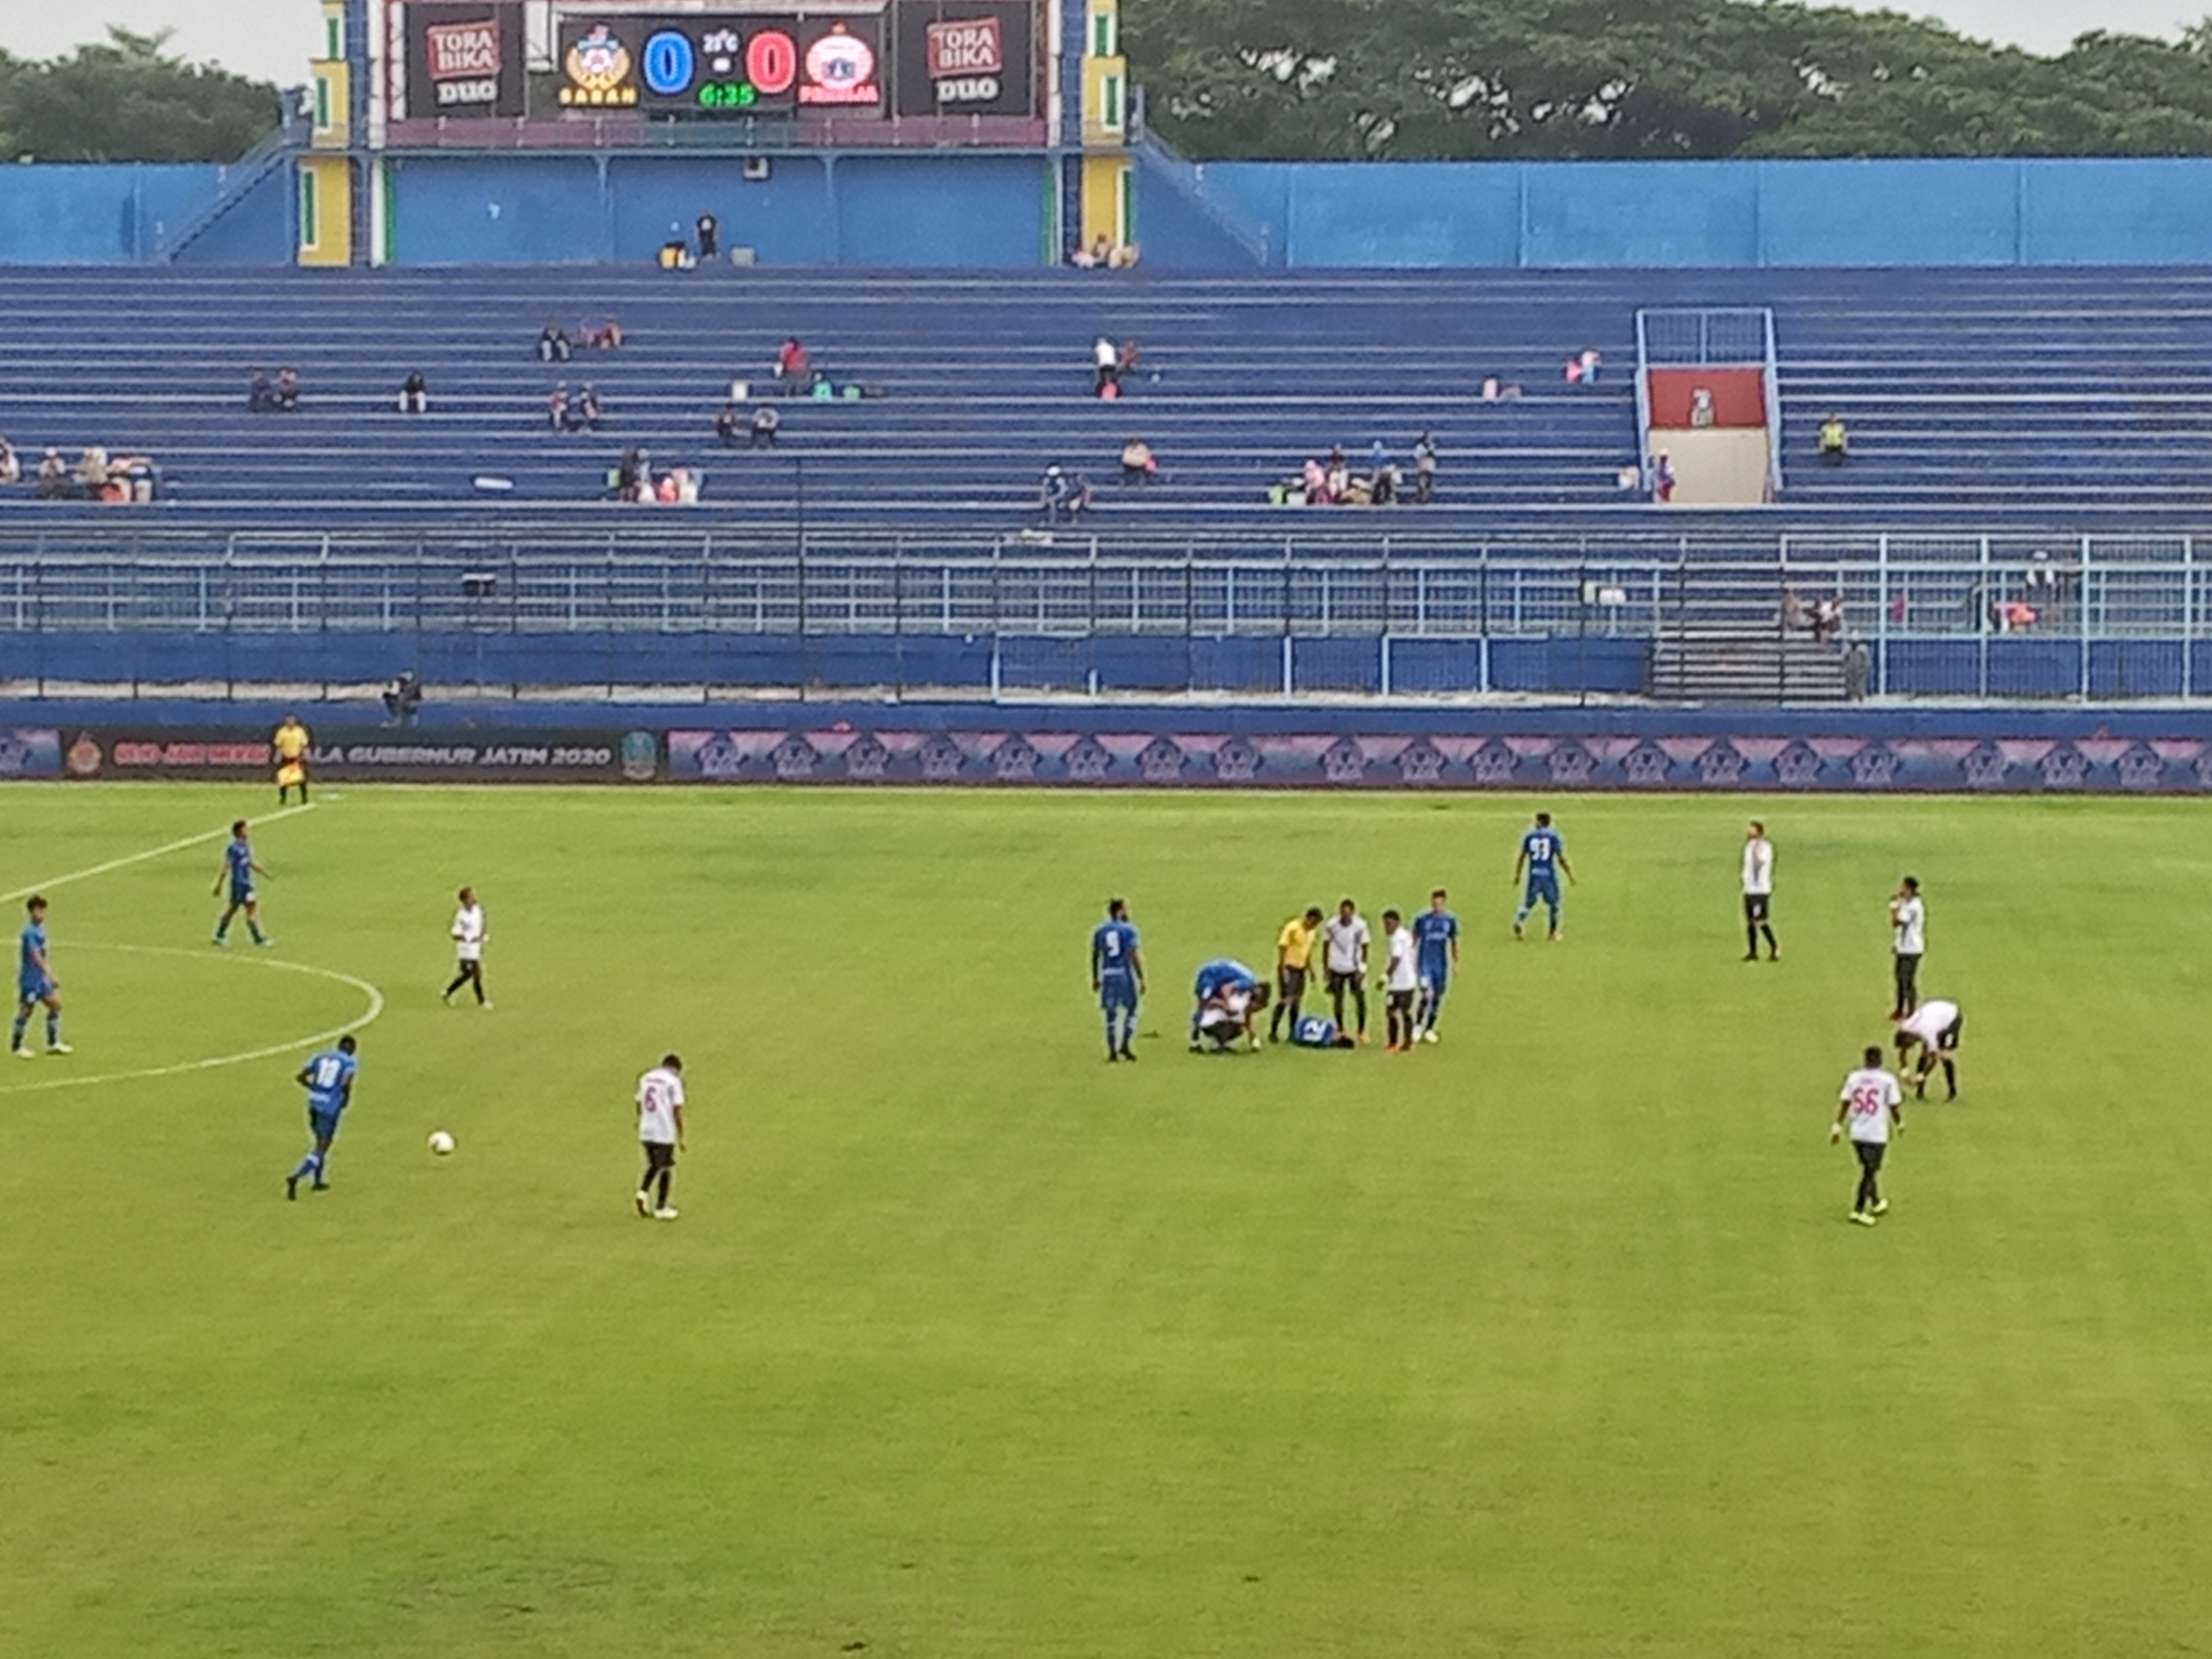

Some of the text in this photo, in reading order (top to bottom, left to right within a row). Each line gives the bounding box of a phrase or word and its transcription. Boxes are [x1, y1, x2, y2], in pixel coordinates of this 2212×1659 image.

[432, 29, 493, 52] TORA
[930, 27, 994, 50] TORA
[438, 49, 493, 70] BIKA
[644, 31, 693, 94] 0
[747, 32, 796, 94] 0
[938, 46, 994, 68] BIKA
[437, 79, 497, 105] DUO
[937, 76, 998, 102] DUO
[348, 746, 476, 764] GUBERNUR
[478, 746, 548, 766] JATIM
[551, 747, 611, 765] 2020
[1106, 930, 1120, 958] 9
[644, 1086, 657, 1113] 6
[1852, 1087, 1879, 1117] 56
